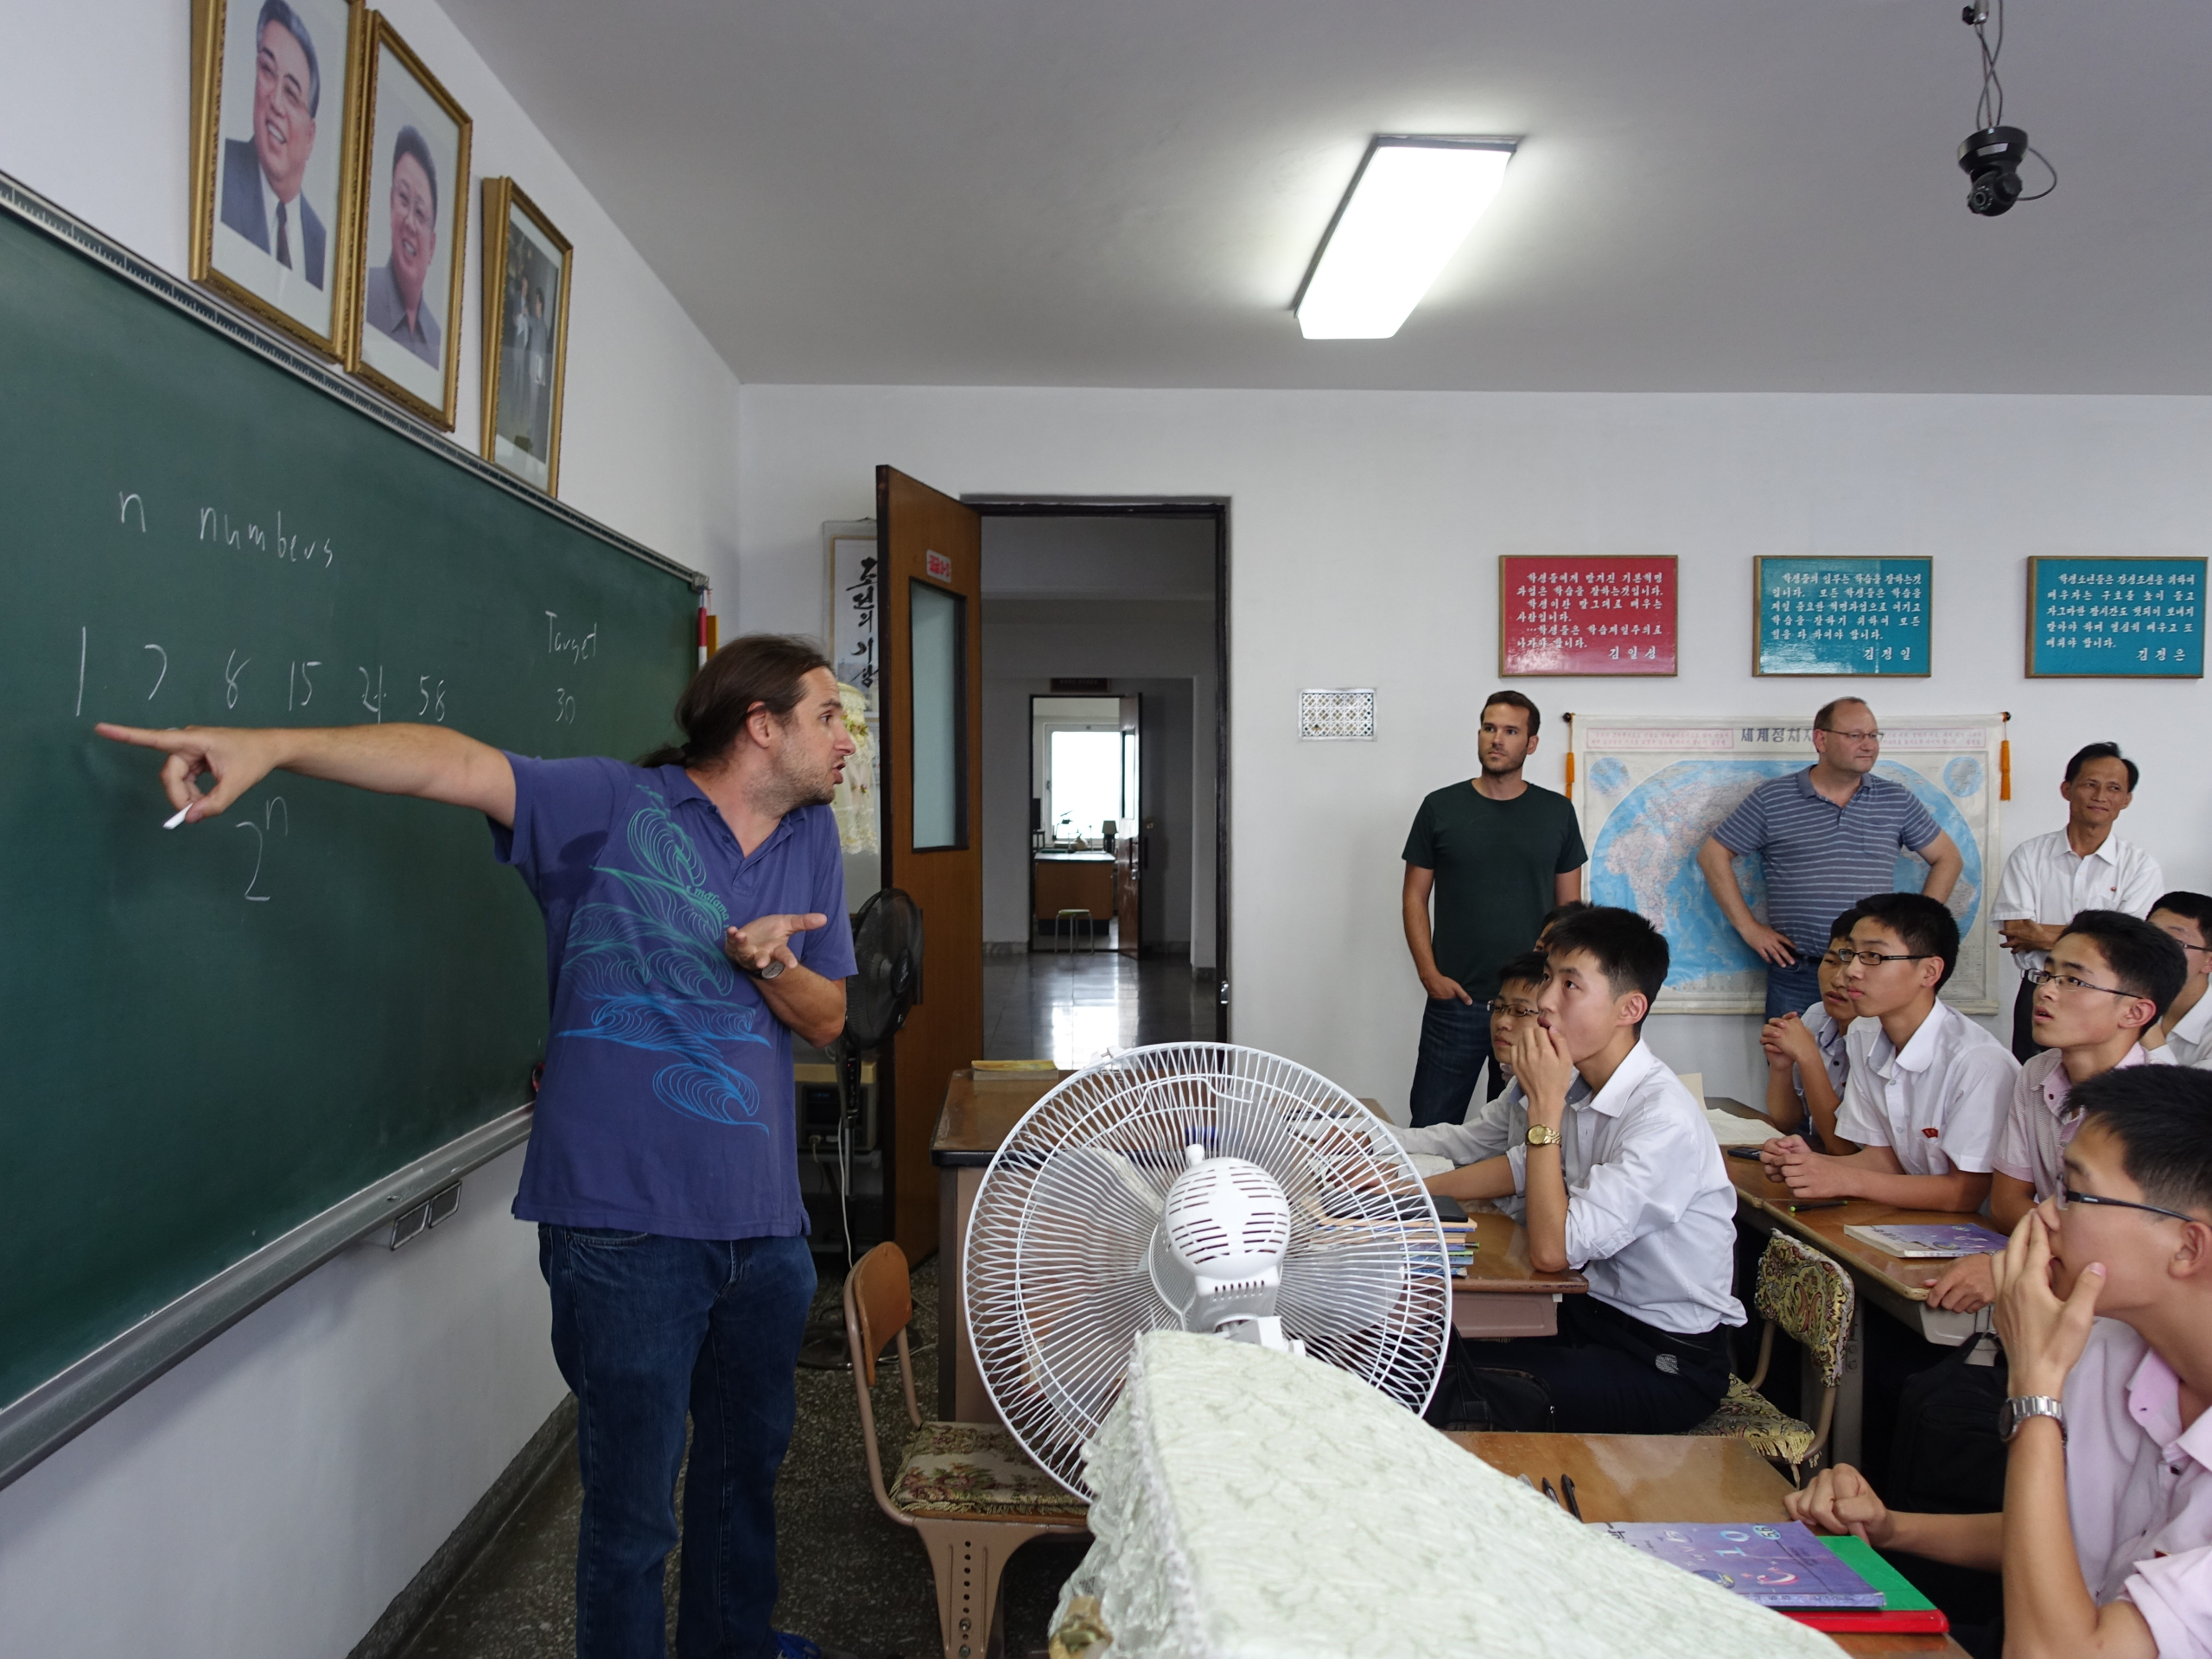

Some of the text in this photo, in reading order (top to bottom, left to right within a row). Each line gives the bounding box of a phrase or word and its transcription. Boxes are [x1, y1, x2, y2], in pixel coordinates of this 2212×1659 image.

[119, 490, 334, 569] n numbers
[1526, 572, 1579, 584] 학생들에게
[1853, 573, 1883, 585] 학습을
[1516, 585, 1548, 597] 과업은
[1553, 585, 1585, 597] 학습을
[1844, 587, 1885, 599] 학생들은
[1891, 587, 1923, 599] 학습을
[1630, 598, 1663, 610] 배우는
[1770, 614, 1805, 626] 학습을
[544, 609, 597, 665] Target
[288, 660, 323, 712] 15
[419, 675, 448, 722] 58
[555, 687, 576, 725] 30
